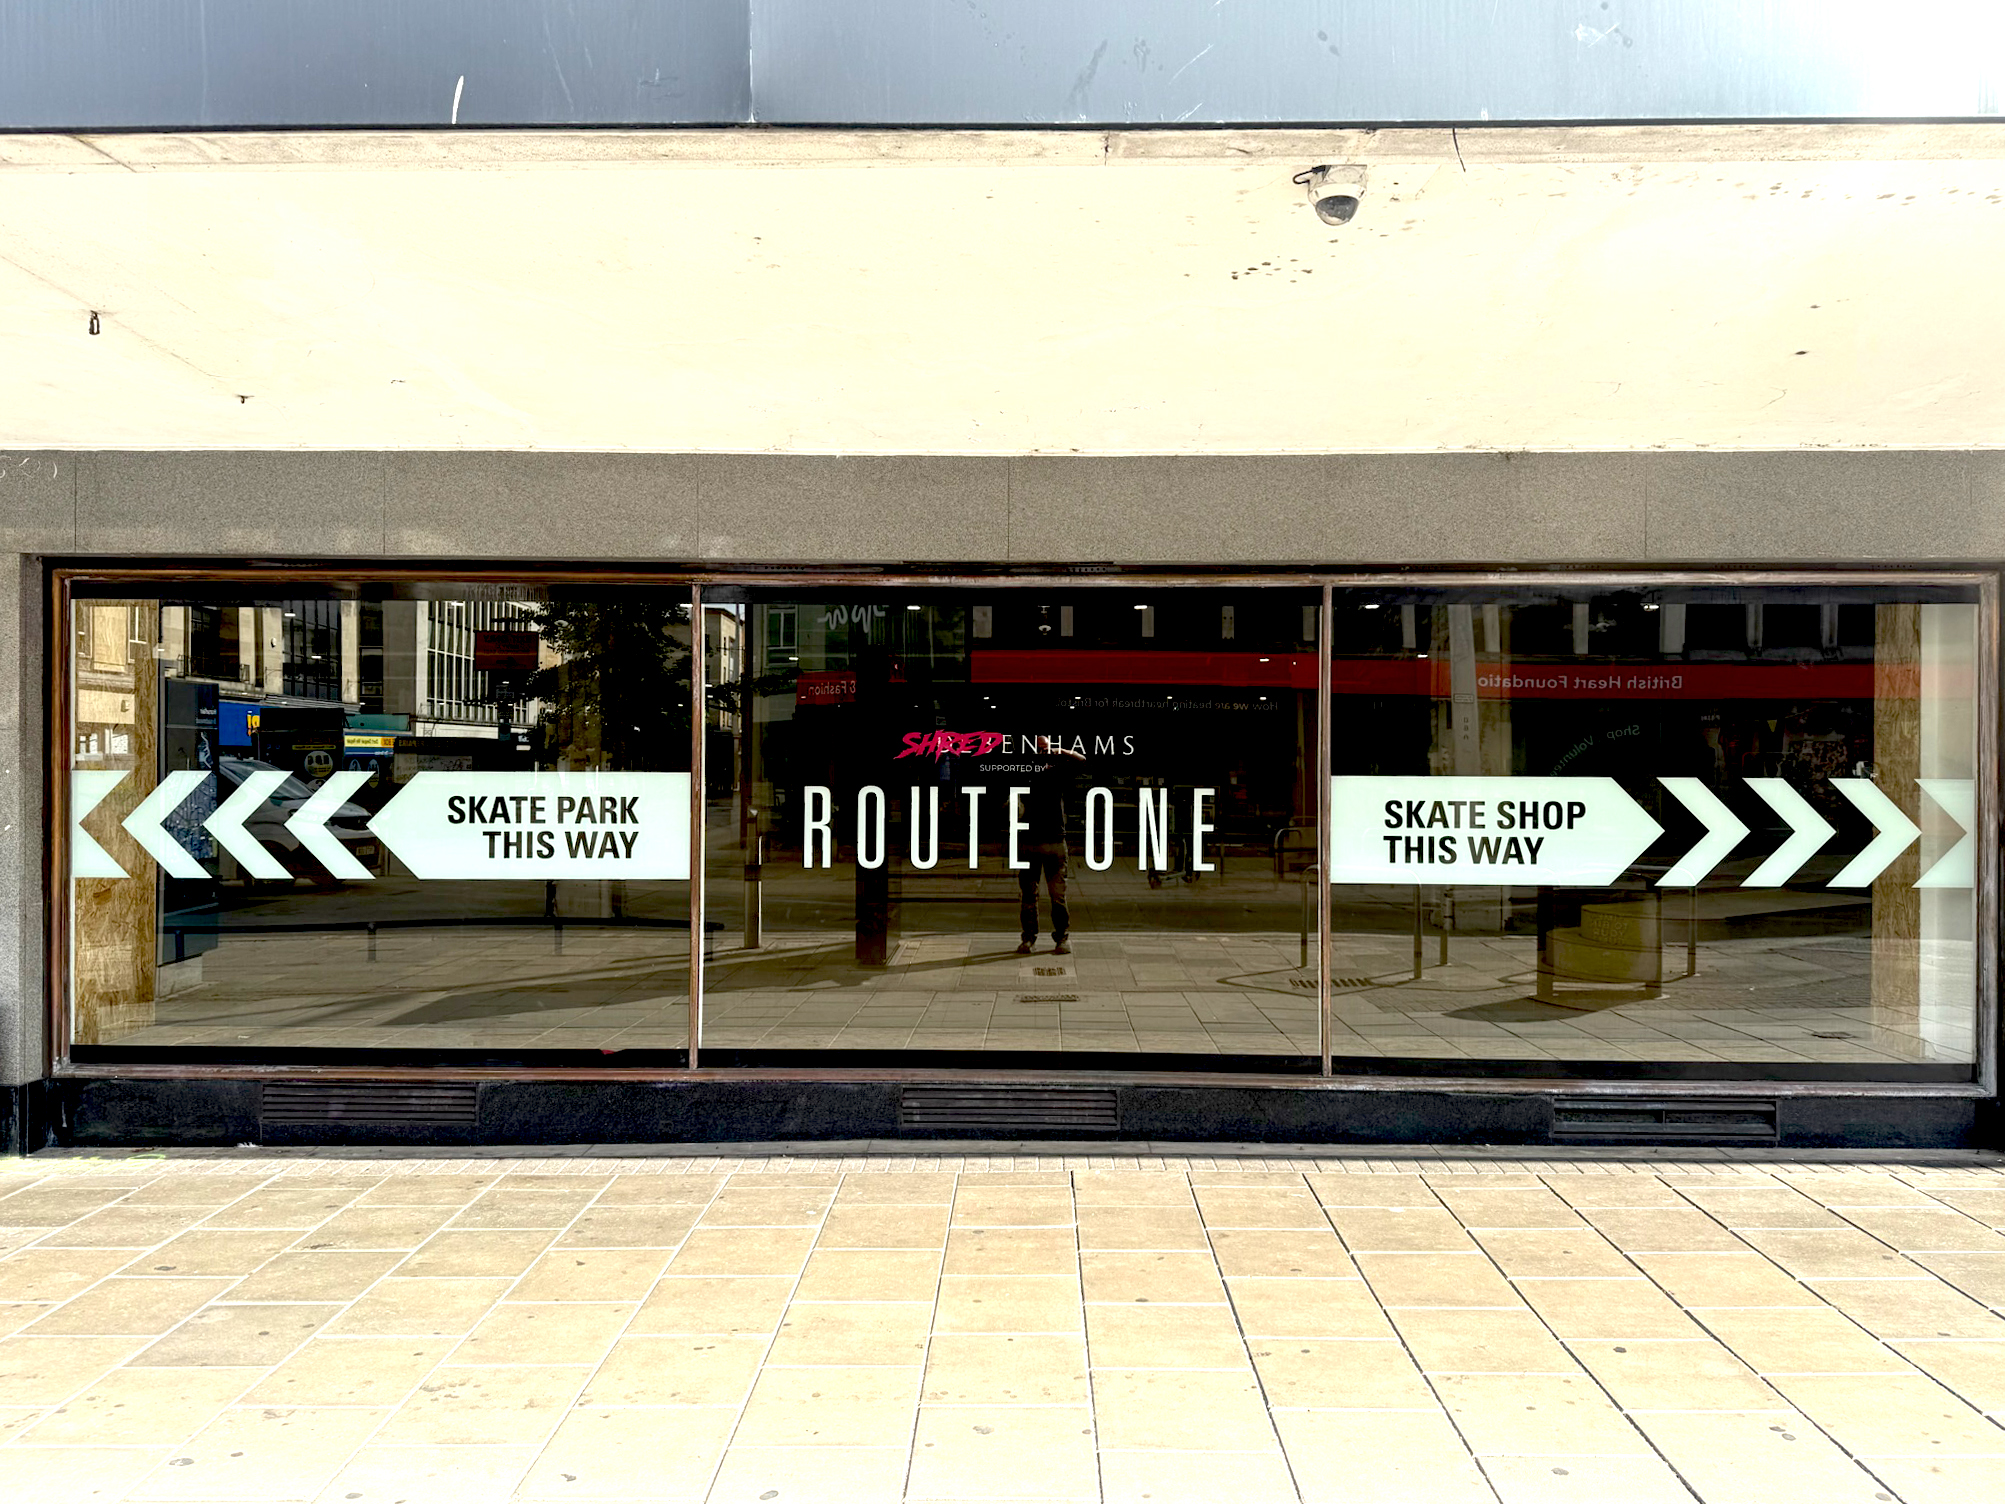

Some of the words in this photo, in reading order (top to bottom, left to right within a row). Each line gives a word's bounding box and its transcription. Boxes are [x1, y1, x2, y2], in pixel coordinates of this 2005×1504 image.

[893, 729, 1003, 764] SHRED
[979, 763, 1033, 773] SUPPORTED
[1034, 763, 1046, 773] BY
[447, 795, 546, 825] SKATE
[557, 796, 640, 825] PARK
[1384, 799, 1486, 829] SKATE
[1496, 800, 1587, 829] SHOP
[803, 785, 1031, 870] ROUTE
[1085, 787, 1215, 872] ONE
[482, 830, 555, 860] THIS
[564, 830, 640, 859] WAY
[1382, 835, 1458, 865] THIS
[1467, 836, 1545, 865] WAY
